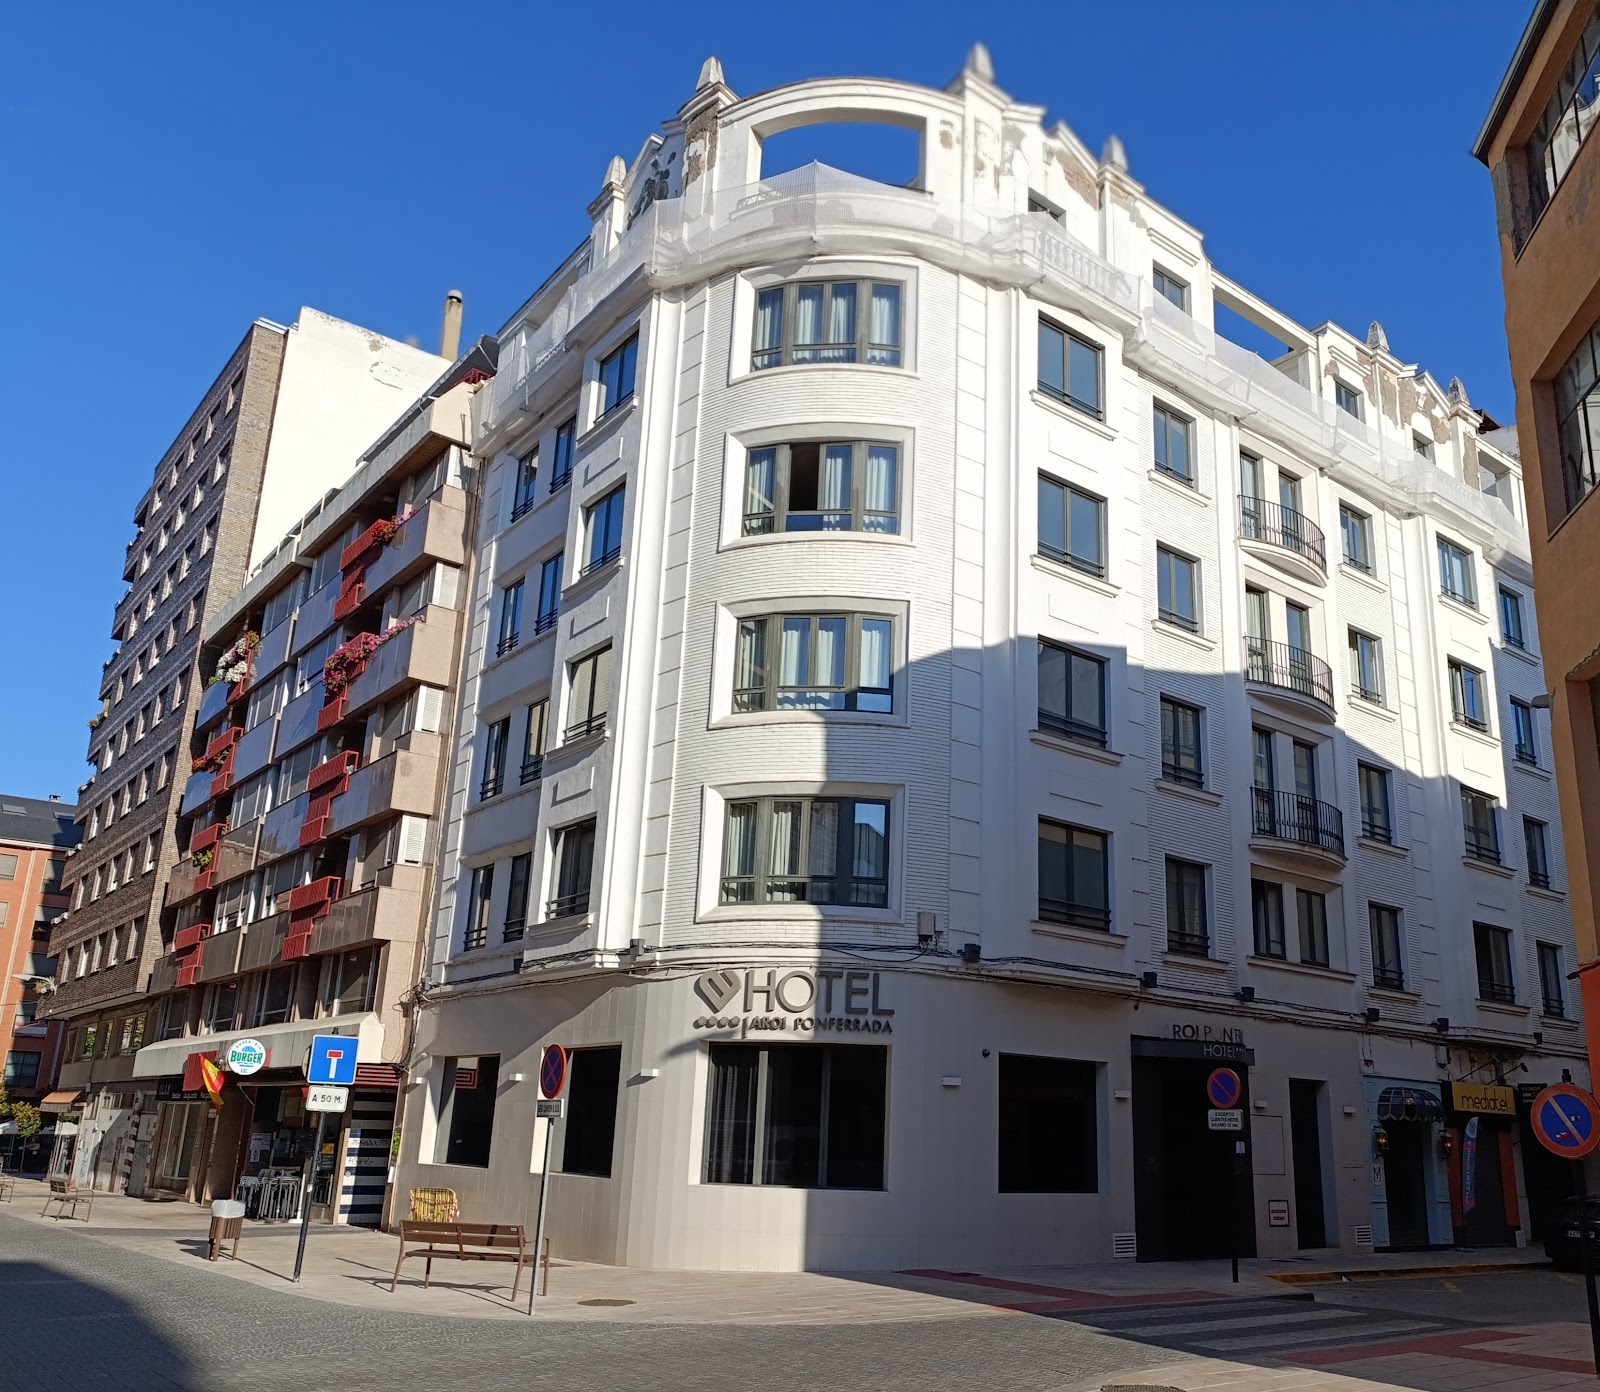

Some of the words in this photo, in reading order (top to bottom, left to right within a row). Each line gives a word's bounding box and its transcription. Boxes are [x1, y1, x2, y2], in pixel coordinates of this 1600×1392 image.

[743, 970, 895, 1015] HOTEL
[749, 1016, 787, 1030] AROI
[794, 1017, 893, 1034] PONFERRADA
[230, 1050, 263, 1064] BURGER
[1203, 1044, 1236, 1058] HOTEL
[312, 1094, 318, 1102] A
[320, 1094, 332, 1103] 50
[1461, 1086, 1508, 1112] mediatel
